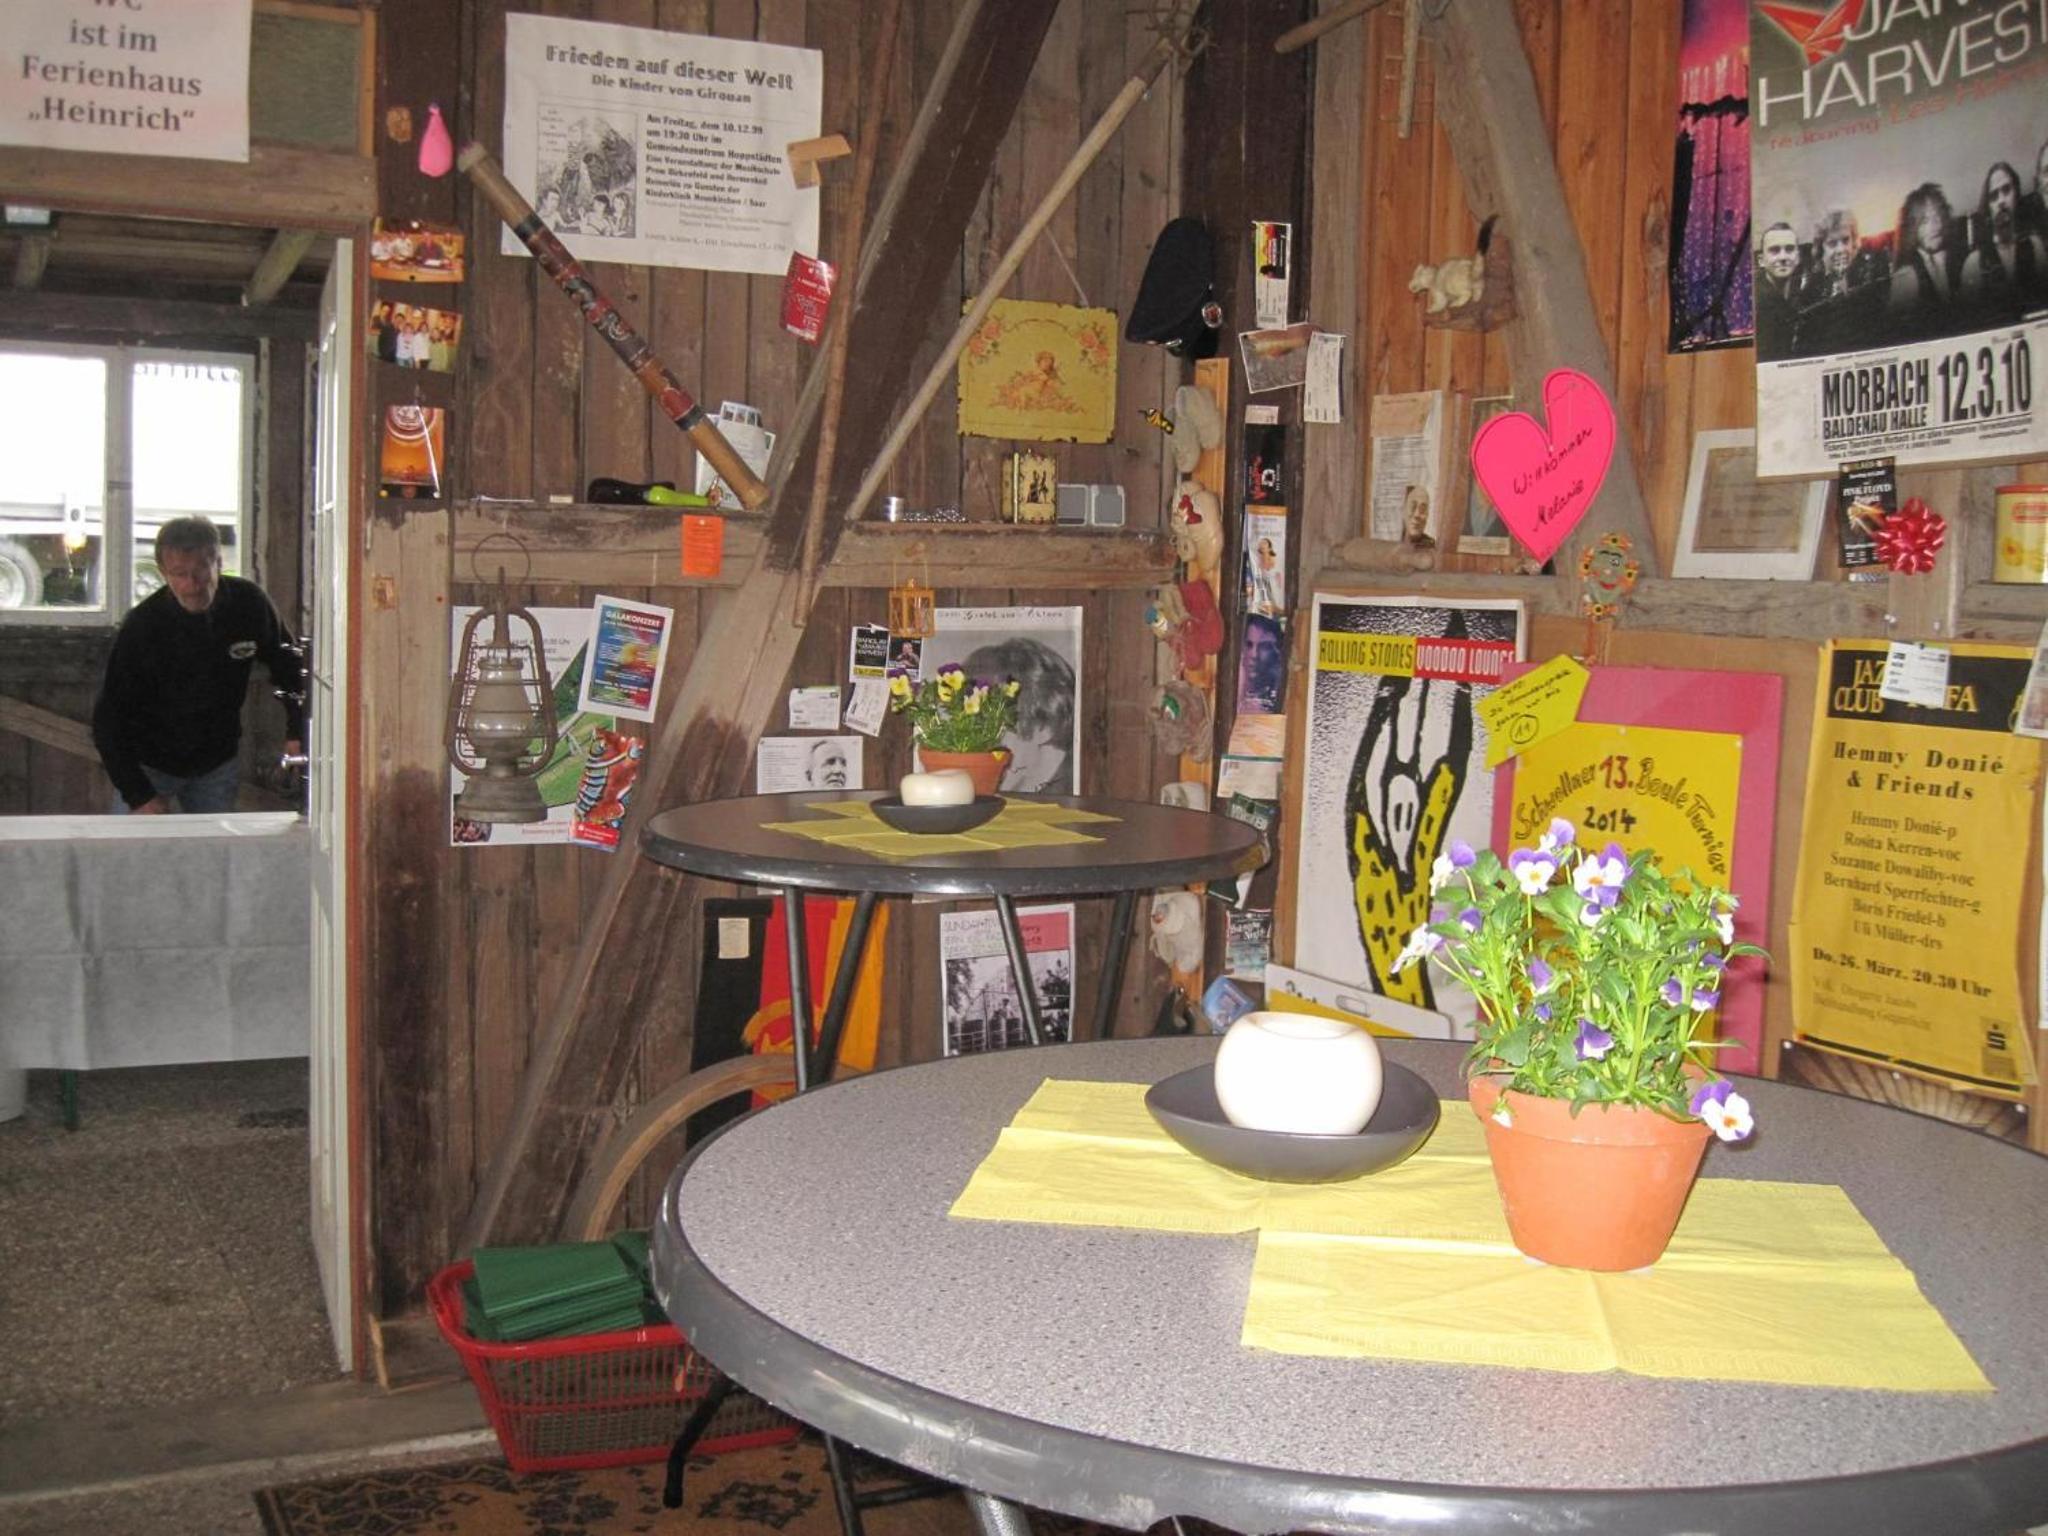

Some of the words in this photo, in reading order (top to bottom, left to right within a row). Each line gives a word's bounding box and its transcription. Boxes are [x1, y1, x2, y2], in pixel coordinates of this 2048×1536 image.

[69, 19, 109, 46] ist
[118, 25, 157, 52] im
[21, 54, 202, 97] Ferienhaus
[546, 45, 629, 69] Frieden
[635, 58, 670, 75] auf
[674, 60, 738, 83] dieser
[744, 68, 793, 90] Welt
[592, 74, 616, 87] Die
[619, 77, 663, 93] Kinder
[669, 86, 693, 97] von
[1823, 358, 1929, 418] MORBACH
[1937, 338, 2031, 422] 12.3.10
[1823, 411, 1888, 440] BALDENAU
[1890, 406, 1927, 431] HALLE
[1513, 427, 1592, 495] Willkommen
[1319, 638, 1366, 666] ROLLING
[1370, 641, 1413, 669] STONES
[1417, 645, 1465, 674] VOODOO
[1469, 648, 1515, 676] LOUN
[1853, 659, 1886, 688] JAZ
[1834, 686, 1885, 714] CLUB
[1834, 741, 1909, 769] Hemmy
[1925, 749, 2004, 775] Donié
[1846, 770, 1862, 788] &
[1875, 773, 1975, 801] Friends
[1583, 805, 1637, 834] 2014
[1600, 755, 1634, 790] 13.
[1634, 757, 1689, 809] Boule
[1686, 793, 1726, 875] Turnier
[1851, 810, 1899, 833] Hemmy
[1961, 979, 1992, 998] Uhr
